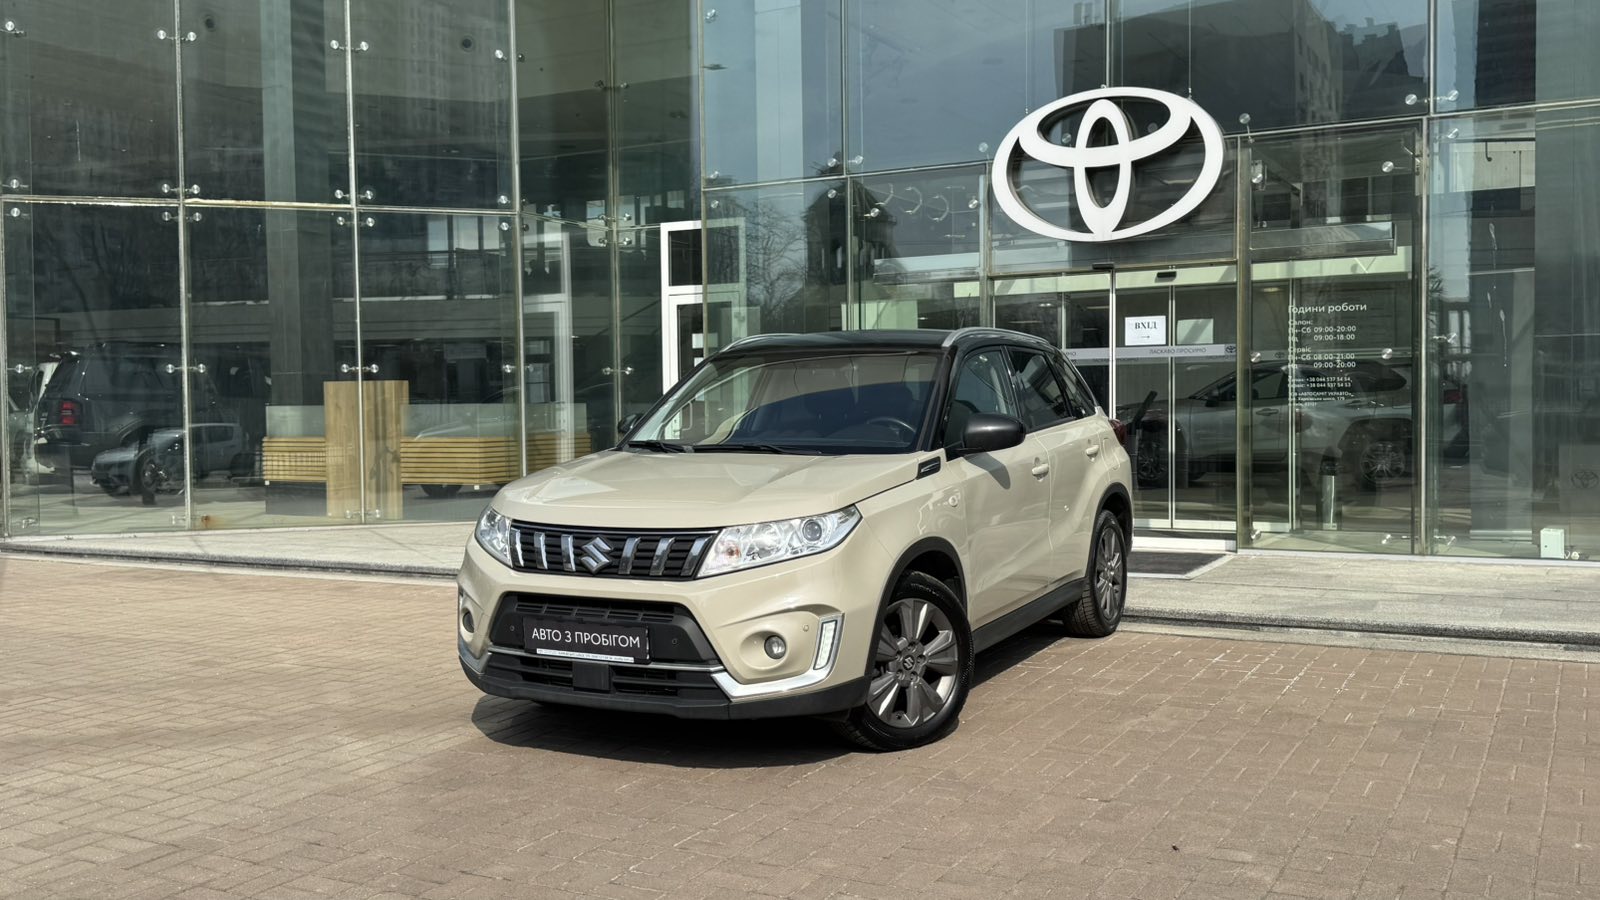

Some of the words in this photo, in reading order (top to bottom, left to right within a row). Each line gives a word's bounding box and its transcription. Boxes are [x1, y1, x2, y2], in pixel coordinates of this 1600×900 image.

[1288, 305, 1325, 314] Години
[1328, 302, 1367, 314] роботи
[1134, 321, 1158, 330] ВХІД
[1313, 325, 1357, 333] 09:00-20:00
[532, 628, 562, 642] АВТО
[574, 631, 640, 648] ПРОБІГОМ
